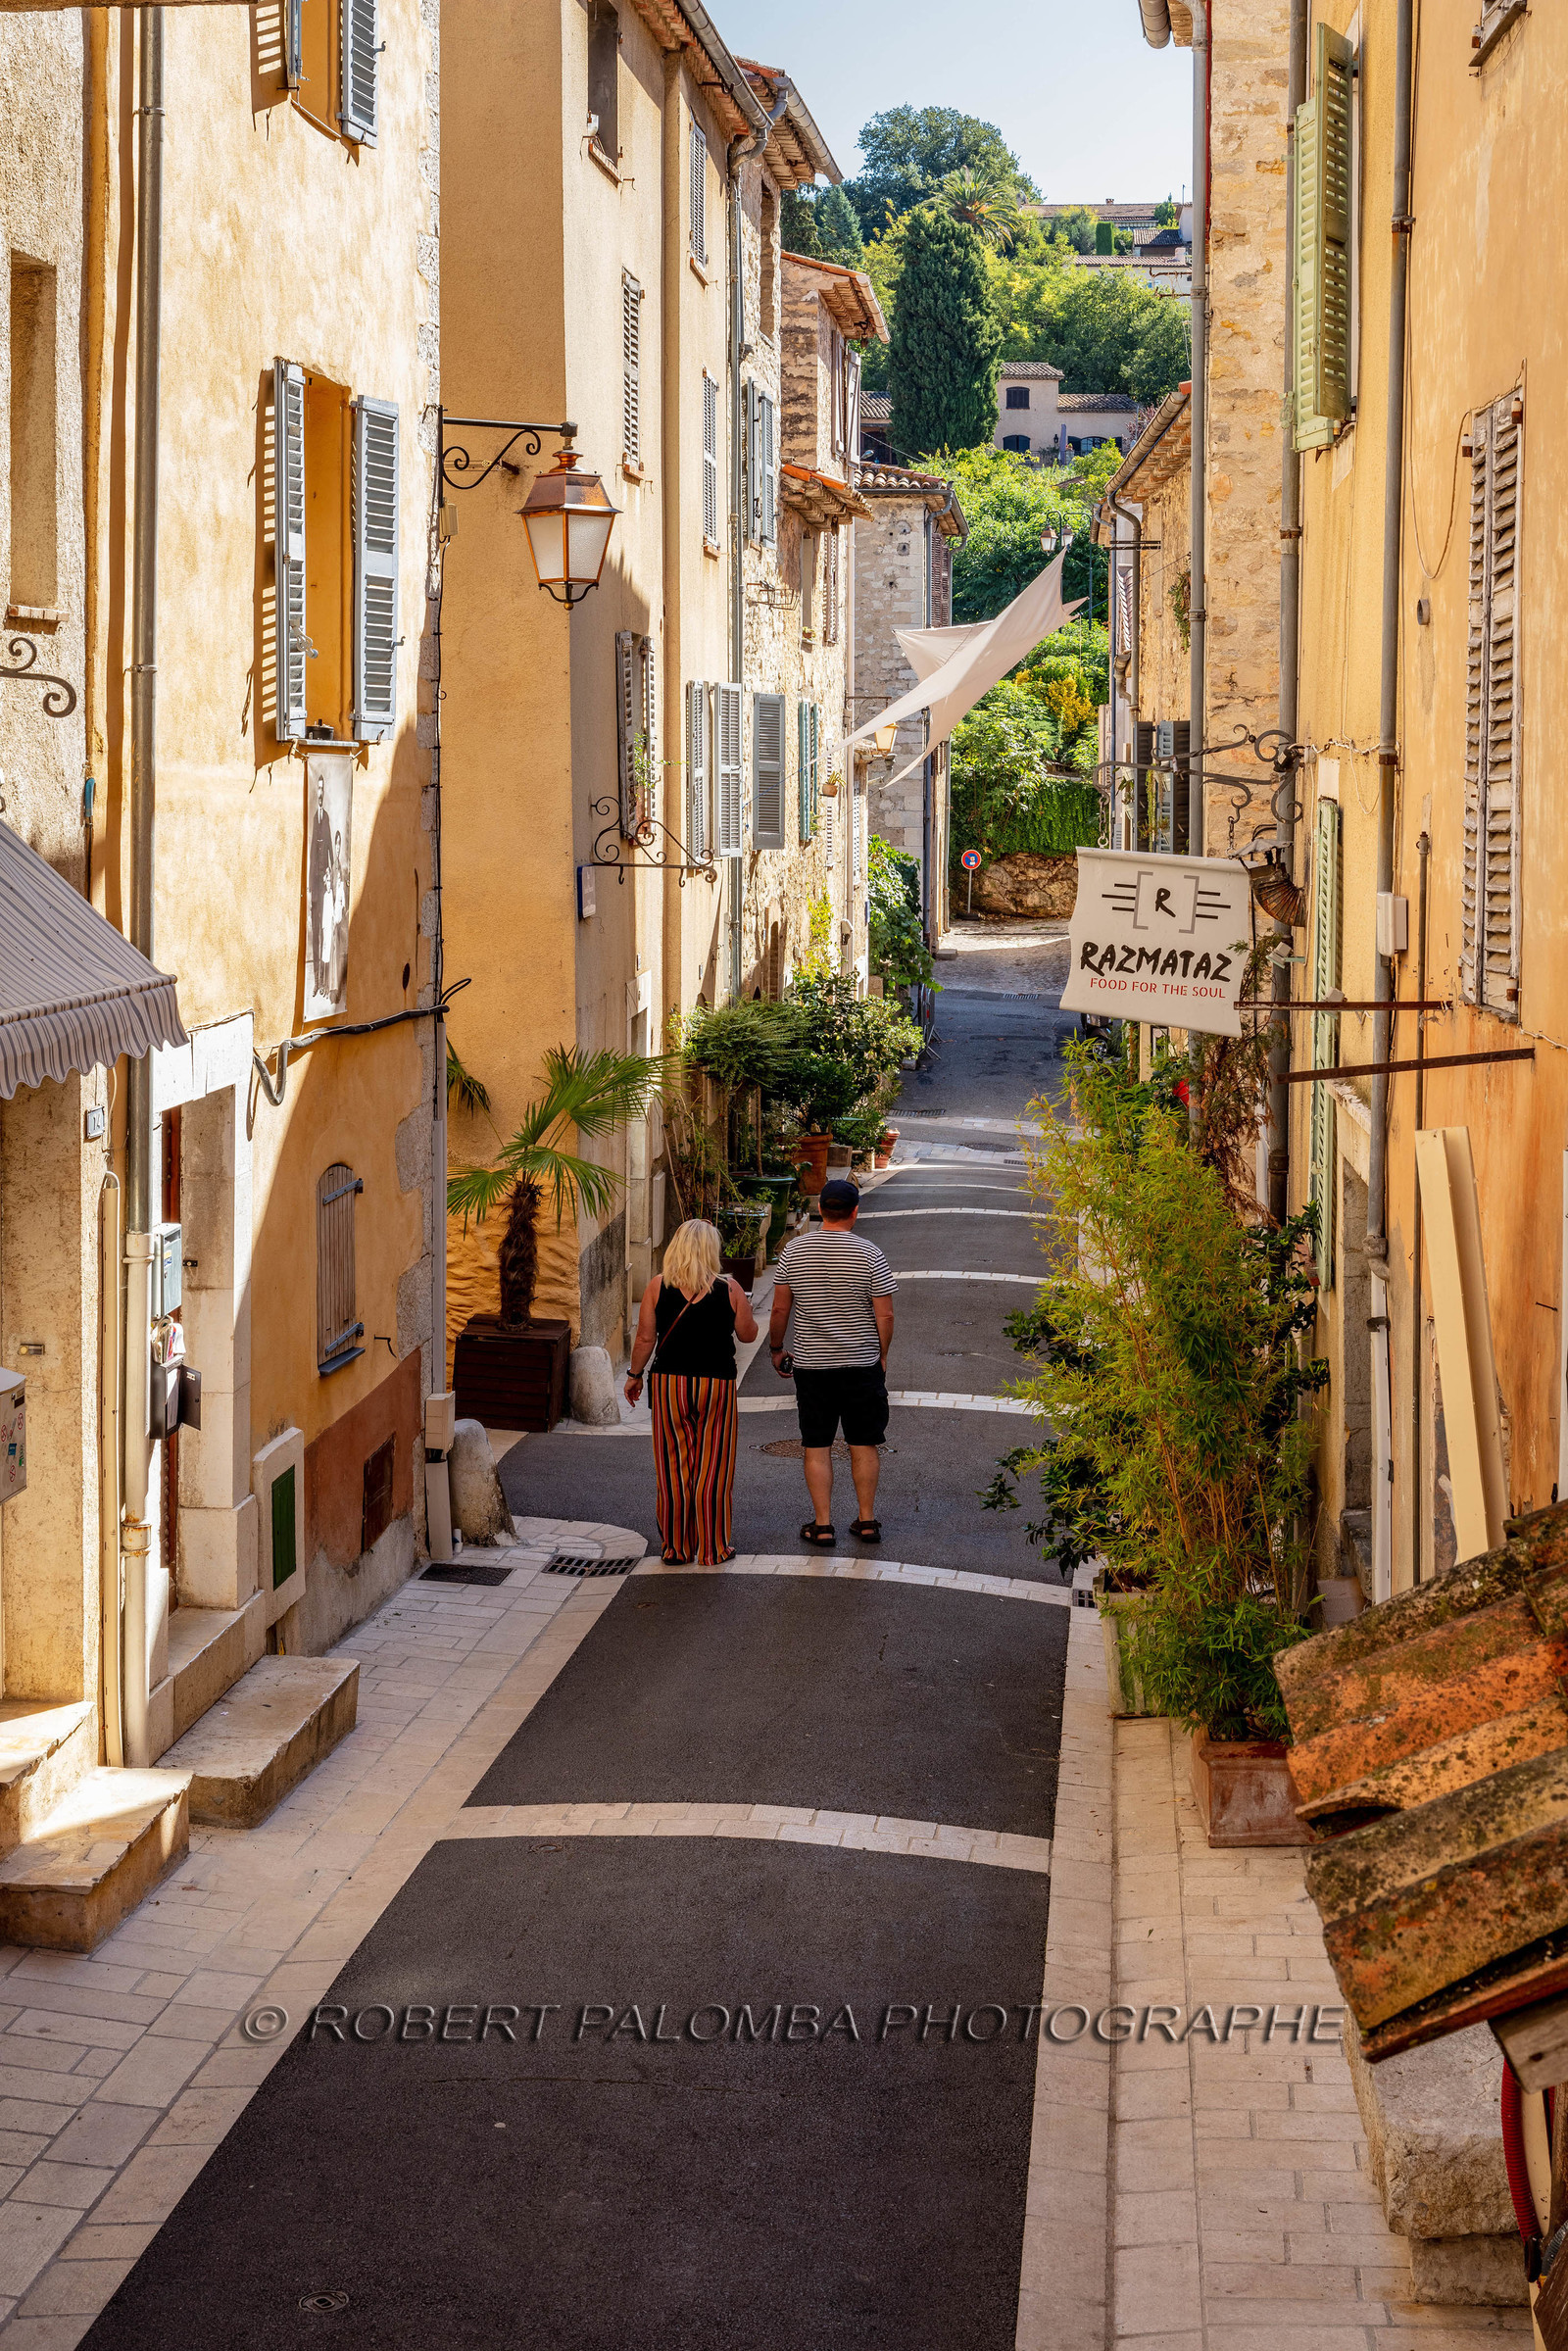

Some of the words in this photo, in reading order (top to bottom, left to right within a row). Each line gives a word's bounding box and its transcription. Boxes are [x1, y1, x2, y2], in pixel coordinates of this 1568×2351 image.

[1154, 887, 1176, 917] R
[1080, 941, 1233, 982] RAZMATAZ
[1090, 978, 1127, 991] FOOD
[1132, 981, 1156, 994] FOR
[1162, 983, 1188, 996] THE
[1193, 987, 1226, 999] SOUL
